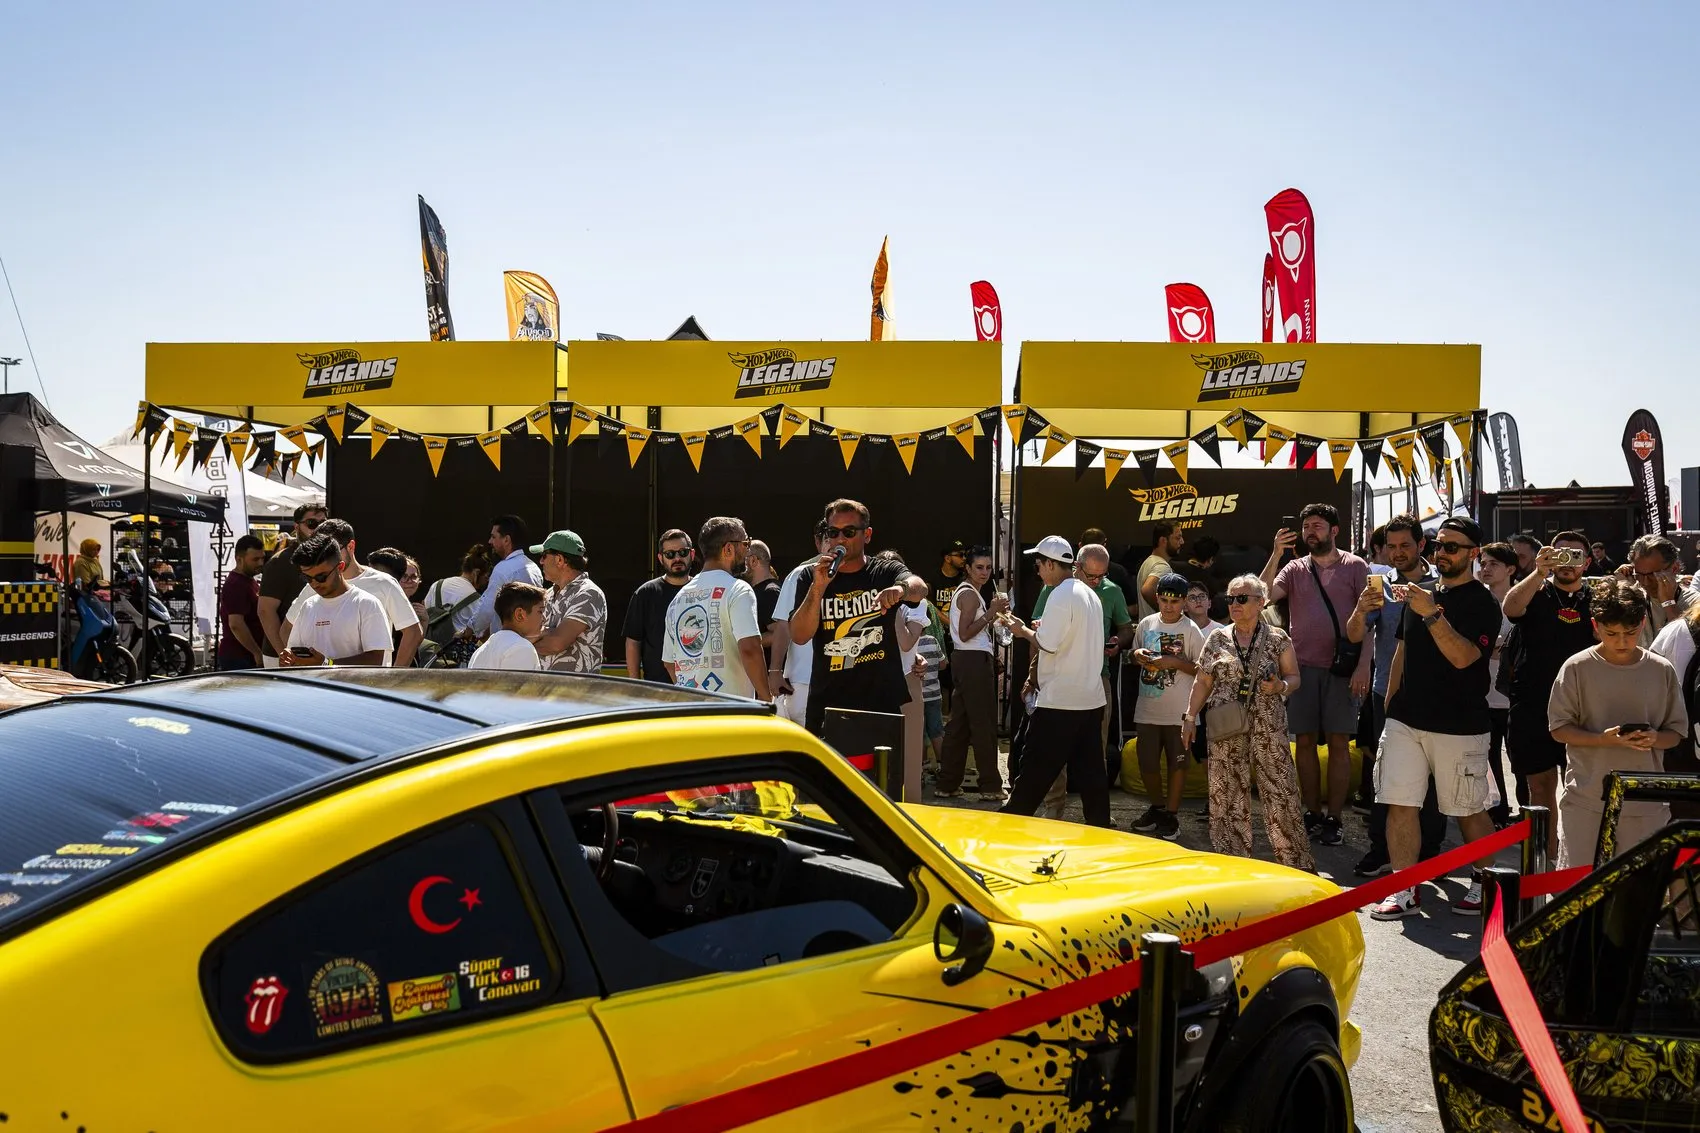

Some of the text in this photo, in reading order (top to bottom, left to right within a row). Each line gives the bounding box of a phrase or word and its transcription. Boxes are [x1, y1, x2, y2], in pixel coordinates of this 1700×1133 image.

[307, 358, 398, 386] LEGENDS
[738, 358, 837, 387] LEGENDS
[1202, 360, 1306, 390] LEGENDS
[331, 383, 366, 395] TÜRKİYE
[764, 383, 801, 395] TÜRKİYE
[1229, 387, 1268, 398] TÜRKİYE
[981, 411, 998, 419] LEGENDS
[1028, 417, 1045, 427] LEGENDS
[716, 429, 733, 439] LEGENDS
[812, 427, 830, 435] LEGENDS
[928, 431, 945, 441] LEGENDS
[1079, 447, 1097, 455] LEGENDS
[1363, 441, 1382, 450] LEGENDS
[1139, 494, 1239, 521] LEGENDS
[1179, 519, 1204, 530] KİYE
[0, 632, 54, 642] ELSLEGENDS
[460, 957, 503, 975] Süper
[468, 965, 530, 989] Türk 16
[317, 1014, 383, 1037] LIMITED EDITION
